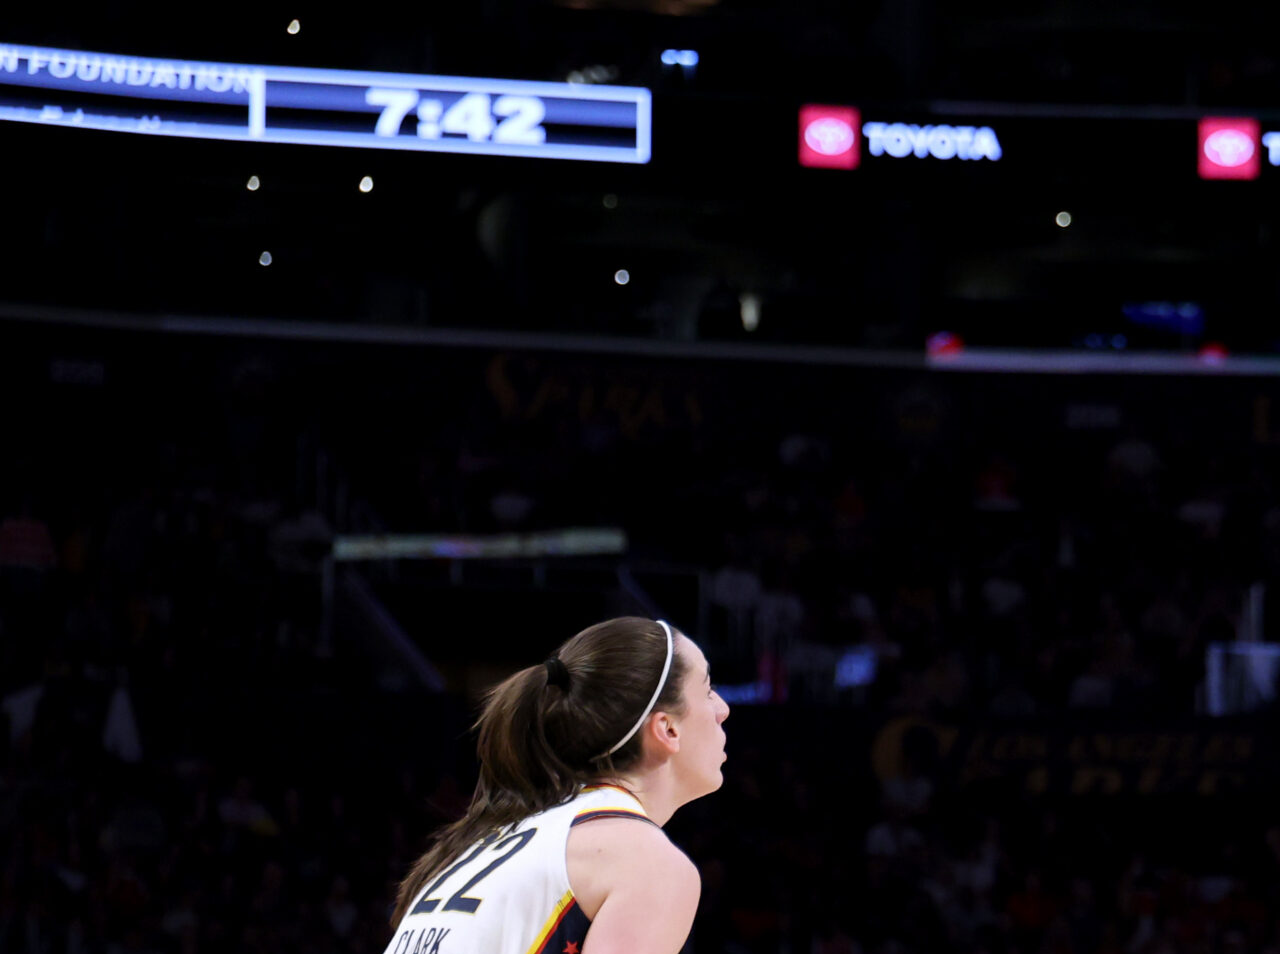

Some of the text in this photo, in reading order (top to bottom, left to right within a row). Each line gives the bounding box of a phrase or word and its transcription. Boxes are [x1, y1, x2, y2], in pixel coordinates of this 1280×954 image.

[27, 51, 252, 94] FOUNDATION
[366, 86, 545, 146] 7:42
[862, 121, 1002, 161] TOYOTA
[409, 827, 538, 917] 22
